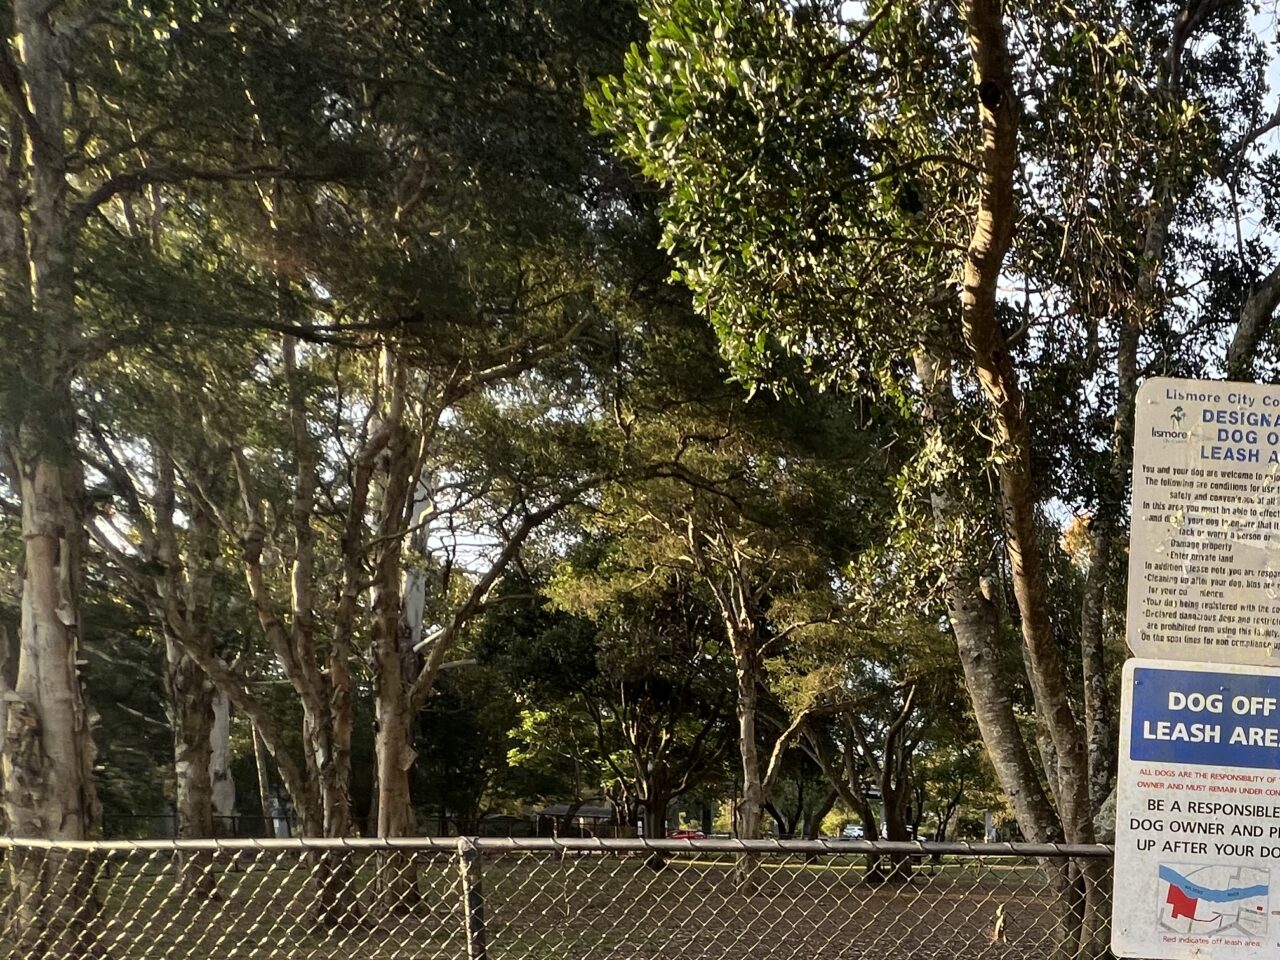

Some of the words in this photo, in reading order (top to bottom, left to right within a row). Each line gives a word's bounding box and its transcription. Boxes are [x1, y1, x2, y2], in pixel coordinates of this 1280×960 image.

[1166, 389, 1220, 403] Lismore
[1228, 394, 1255, 407] City
[1152, 427, 1187, 438] lismore
[1218, 429, 1257, 444] DOG
[1201, 446, 1259, 462] LEASH
[1142, 465, 1154, 473] You
[1157, 466, 1170, 474] and
[1191, 468, 1204, 477] dog
[1221, 470, 1253, 480] welcome
[1256, 472, 1262, 480] to
[1145, 477, 1158, 485] The
[1161, 478, 1194, 488] following
[1210, 482, 1247, 491] conditions
[1250, 484, 1259, 492] for
[1170, 491, 1191, 500] safely
[1194, 493, 1207, 501] and
[1267, 497, 1275, 505] all
[1143, 501, 1150, 509] In
[1153, 502, 1165, 510] this
[1188, 517, 1203, 525] your
[1206, 518, 1219, 527] dog
[1257, 521, 1271, 529] that
[1207, 531, 1228, 539] worry
[1171, 539, 1199, 549] Damage
[1202, 541, 1232, 551] property
[1170, 551, 1188, 560] Enter
[1219, 555, 1233, 563] land
[1154, 563, 1183, 571] addition
[1188, 565, 1208, 573] lease
[1211, 566, 1226, 574] note
[1229, 568, 1241, 576] you
[1147, 574, 1178, 584] Cleaning
[1247, 580, 1260, 588] bins
[1149, 586, 1158, 594] for
[1147, 598, 1161, 606] Your
[1180, 600, 1199, 610] being
[1202, 601, 1237, 610] registered
[1146, 610, 1177, 619] Declared
[1179, 612, 1216, 621] dangerous
[1219, 614, 1235, 623] dogs
[1161, 623, 1196, 631] prohibited
[1199, 625, 1214, 633] from
[1217, 627, 1236, 635] using
[1141, 633, 1150, 641] On
[1153, 634, 1164, 642] the
[1185, 636, 1201, 644] fines
[1204, 637, 1213, 645] for
[1231, 639, 1271, 649] compliance
[1168, 692, 1223, 714] DOG
[1232, 696, 1277, 716] OFF
[1143, 721, 1221, 743] LEASH
[1155, 769, 1176, 777] DOGS
[1178, 770, 1192, 778] ARE
[1210, 773, 1265, 783] RESPONSIBILITY
[1186, 784, 1206, 792] MUST
[1239, 787, 1263, 795] UNDER
[1147, 799, 1164, 811] BE
[1171, 801, 1181, 812] A
[1188, 802, 1280, 818] RESPONSIBLE
[1130, 818, 1163, 831] DOG
[1170, 821, 1224, 835] OWNER
[1231, 825, 1263, 837] AND
[1137, 839, 1155, 851] UP
[1162, 841, 1207, 854] AFTER
[1215, 844, 1254, 857] YOUR
